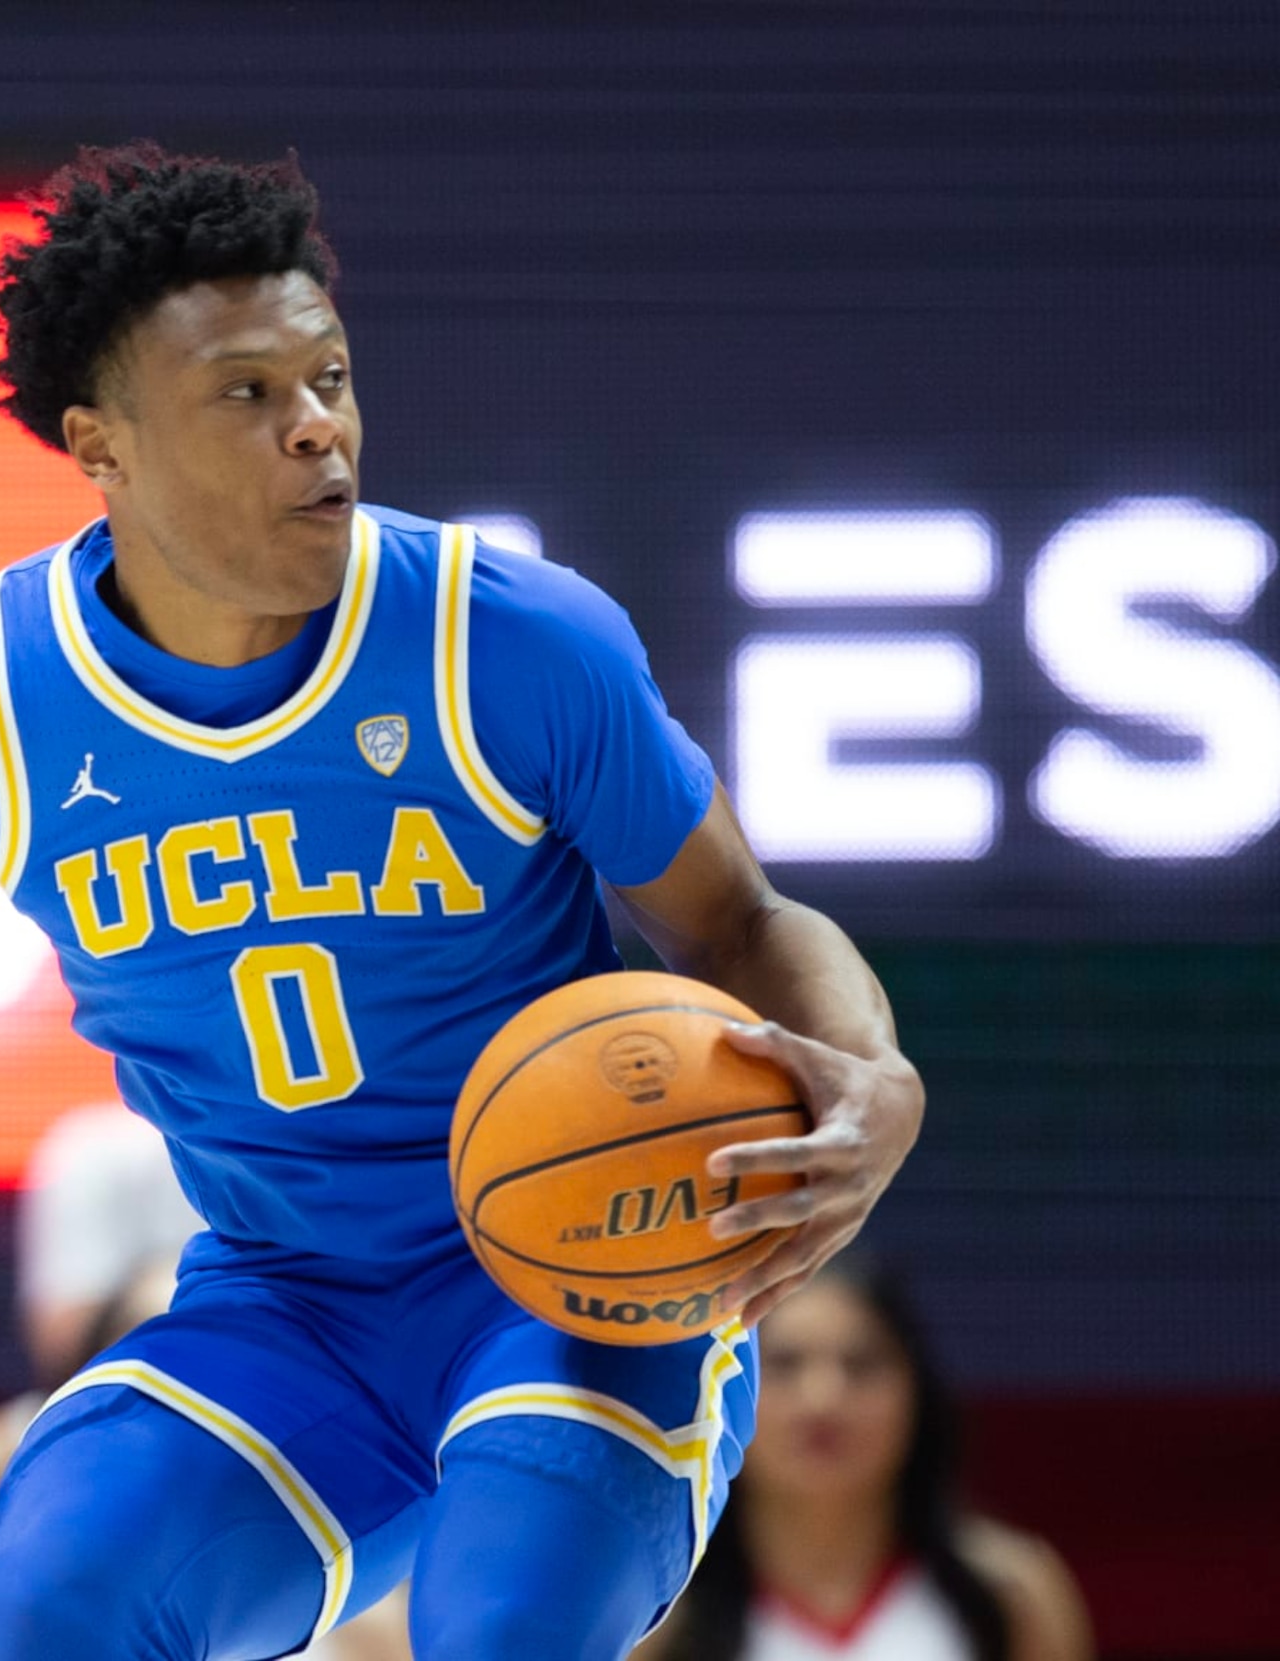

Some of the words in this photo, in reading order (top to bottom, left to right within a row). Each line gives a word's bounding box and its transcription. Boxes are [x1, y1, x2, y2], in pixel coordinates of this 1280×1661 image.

[472, 497, 1280, 862] ES
[54, 807, 486, 959] UCLA
[229, 942, 365, 1113] 0
[561, 1283, 732, 1328] lson
